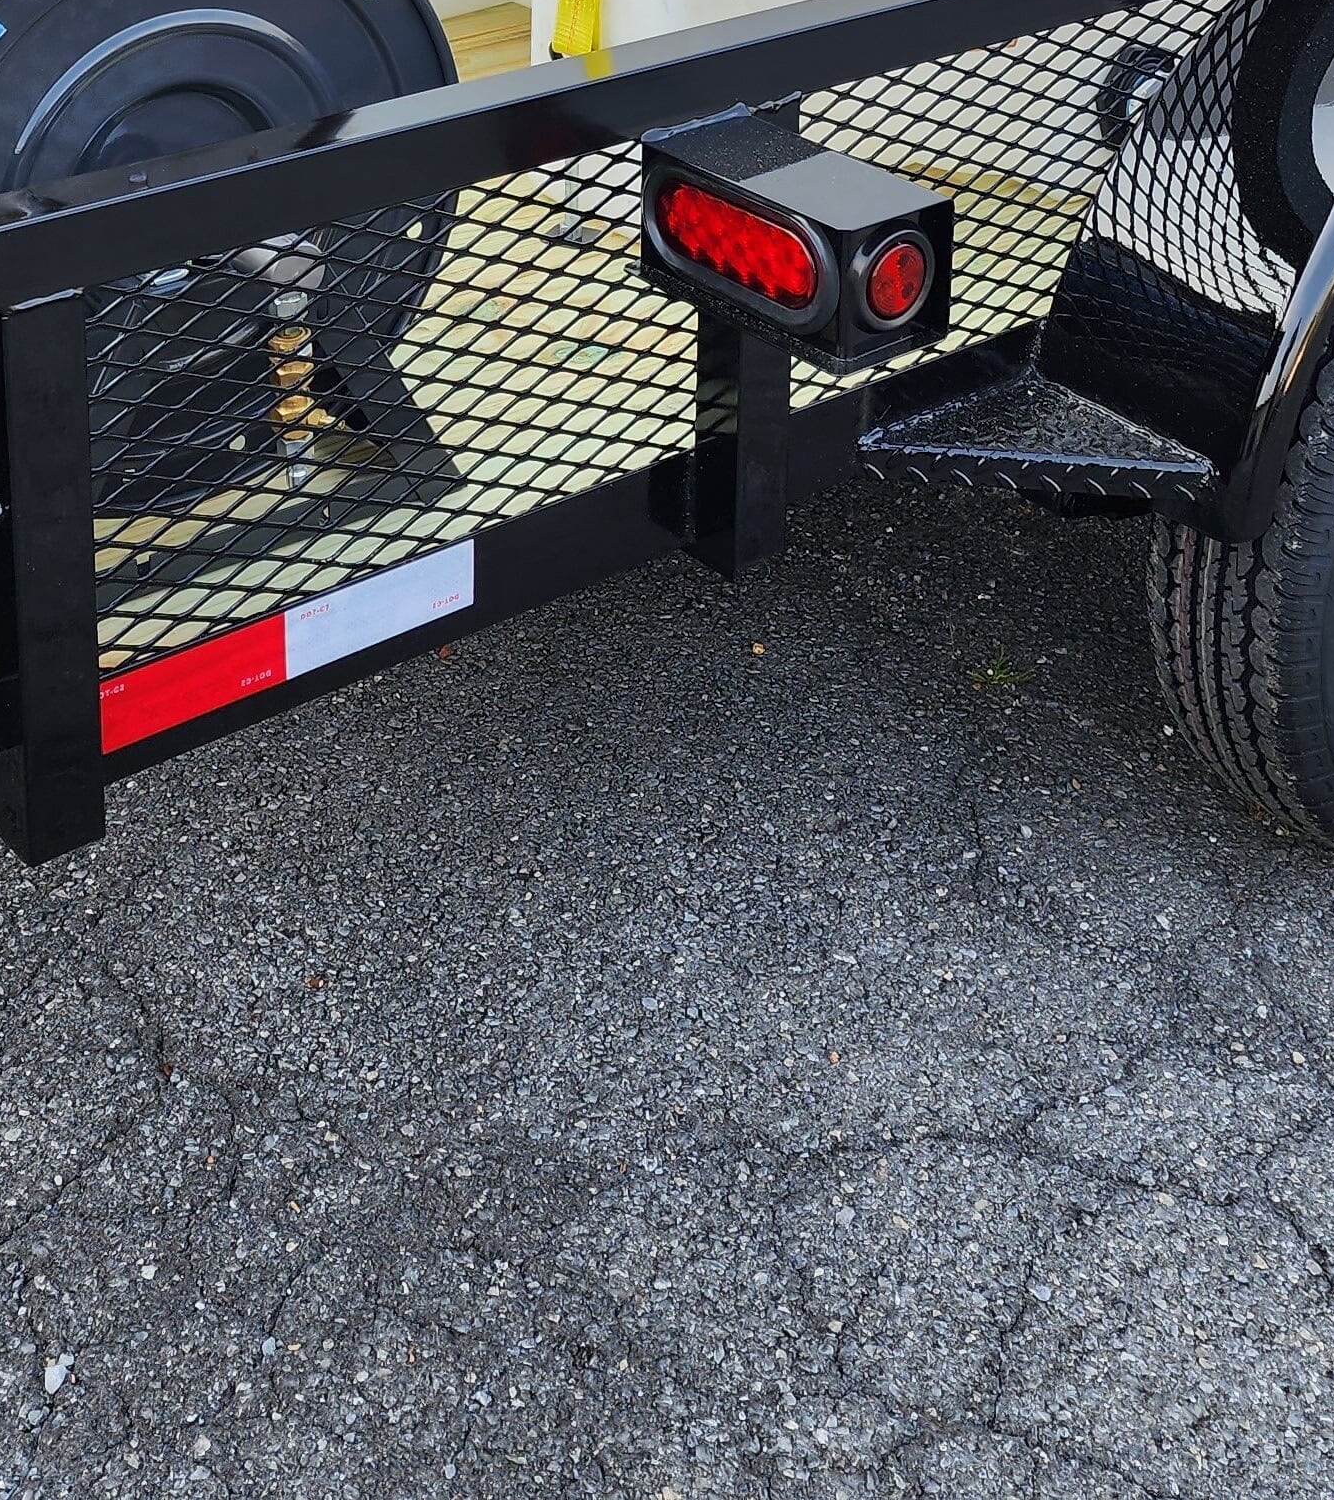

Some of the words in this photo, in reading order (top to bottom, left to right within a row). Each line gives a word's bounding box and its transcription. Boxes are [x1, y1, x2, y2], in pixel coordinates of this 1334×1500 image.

[432, 593, 461, 610] DOT-C2
[300, 603, 330, 621] DOT-C2
[240, 669, 273, 687] DOT-C2
[99, 683, 125, 700] OT-C2
